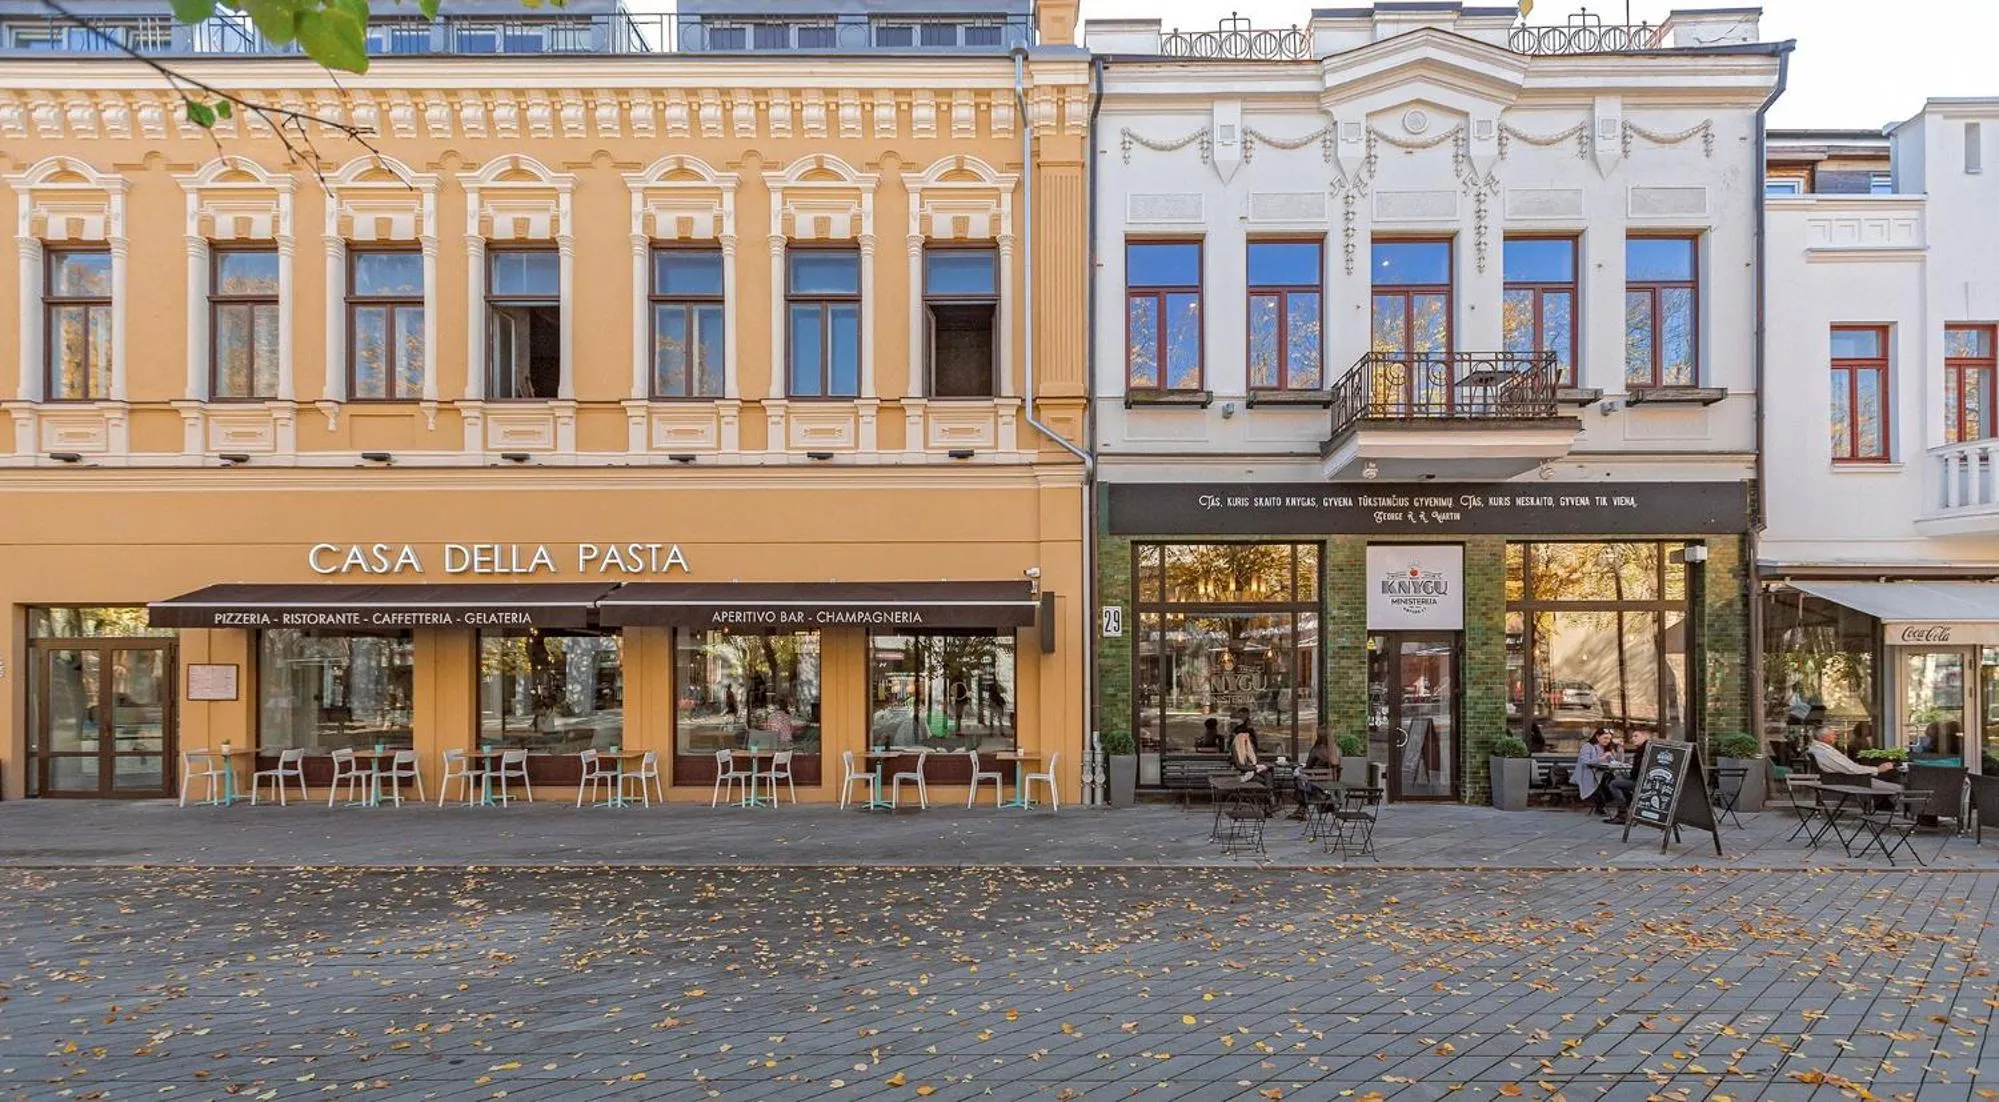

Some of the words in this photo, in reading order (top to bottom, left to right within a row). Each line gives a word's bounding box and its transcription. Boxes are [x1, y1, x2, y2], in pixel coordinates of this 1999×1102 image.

[1227, 497, 1250, 507] KURIS
[1253, 497, 1282, 507] SKAITO
[1285, 497, 1319, 508] KNYGAS,
[1322, 497, 1353, 507] GYVENA
[1488, 497, 1511, 507] KURIS
[1515, 497, 1555, 508] NESKAITO,
[1560, 497, 1591, 506] GYVENA
[1595, 497, 1608, 506] TIK
[308, 543, 422, 573] CASA
[445, 543, 556, 573] DELLA
[578, 543, 689, 573] PASTA
[214, 613, 271, 625] PIZZERIA
[283, 613, 360, 625] RISTORANTE
[372, 612, 452, 625] CAFFETTERIA
[464, 612, 532, 624] GELATERIA
[712, 611, 776, 623] APERITIVO
[780, 611, 804, 622] BAR
[816, 611, 923, 623] CHAMPAGNERIA
[1104, 610, 1120, 632] 29
